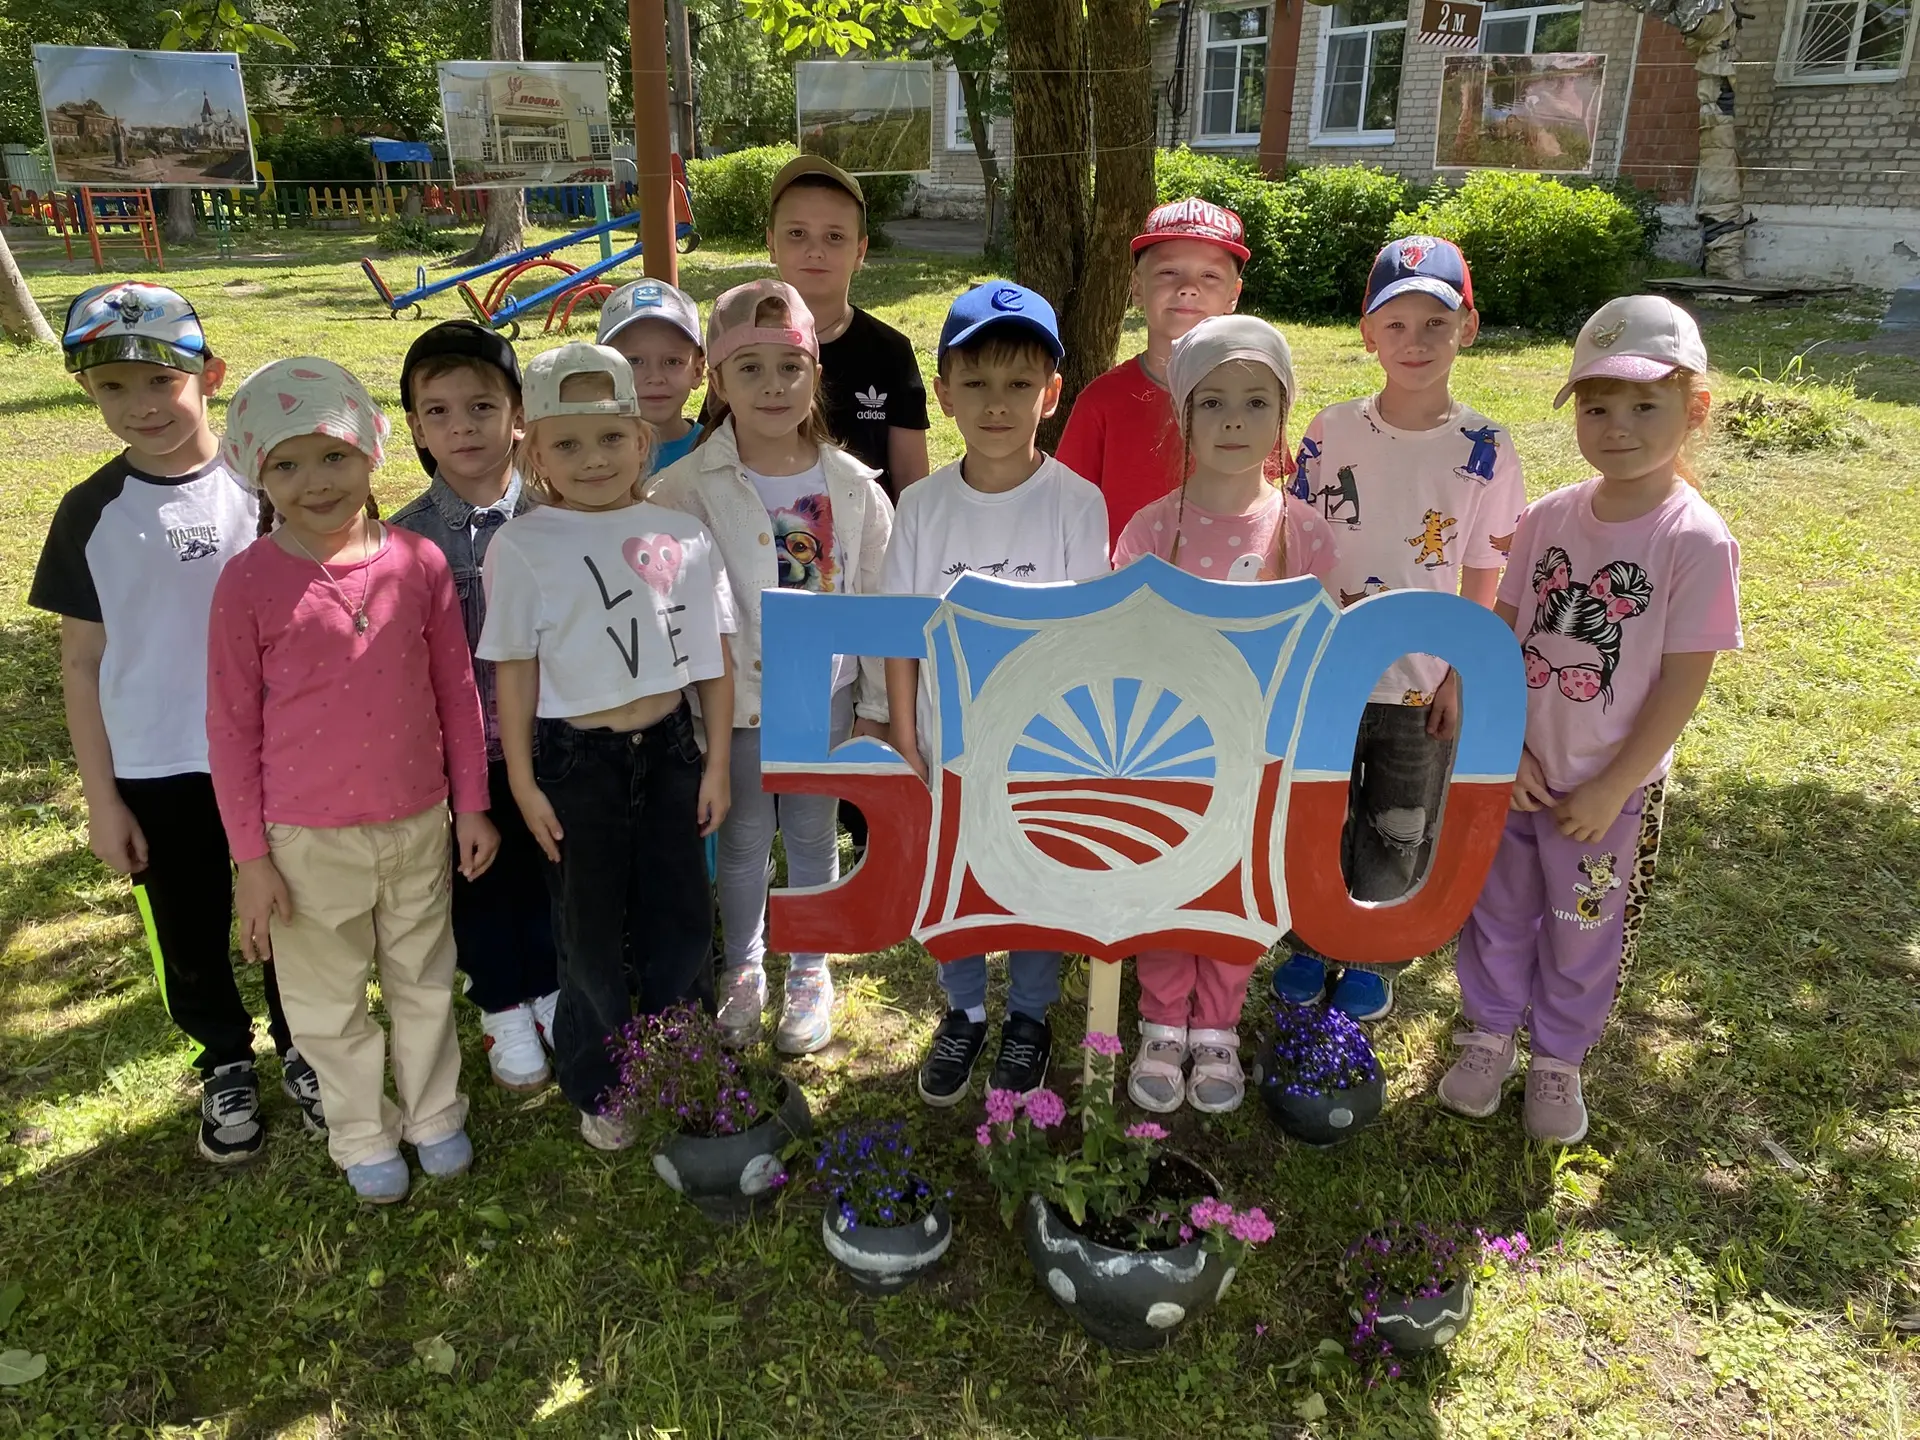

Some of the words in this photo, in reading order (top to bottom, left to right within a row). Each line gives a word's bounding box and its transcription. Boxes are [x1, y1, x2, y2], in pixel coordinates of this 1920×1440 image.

[1437, 3, 1451, 31] 2
[1157, 198, 1232, 235] MARVEL
[856, 409, 887, 420] adidas
[166, 526, 220, 549] NATURE
